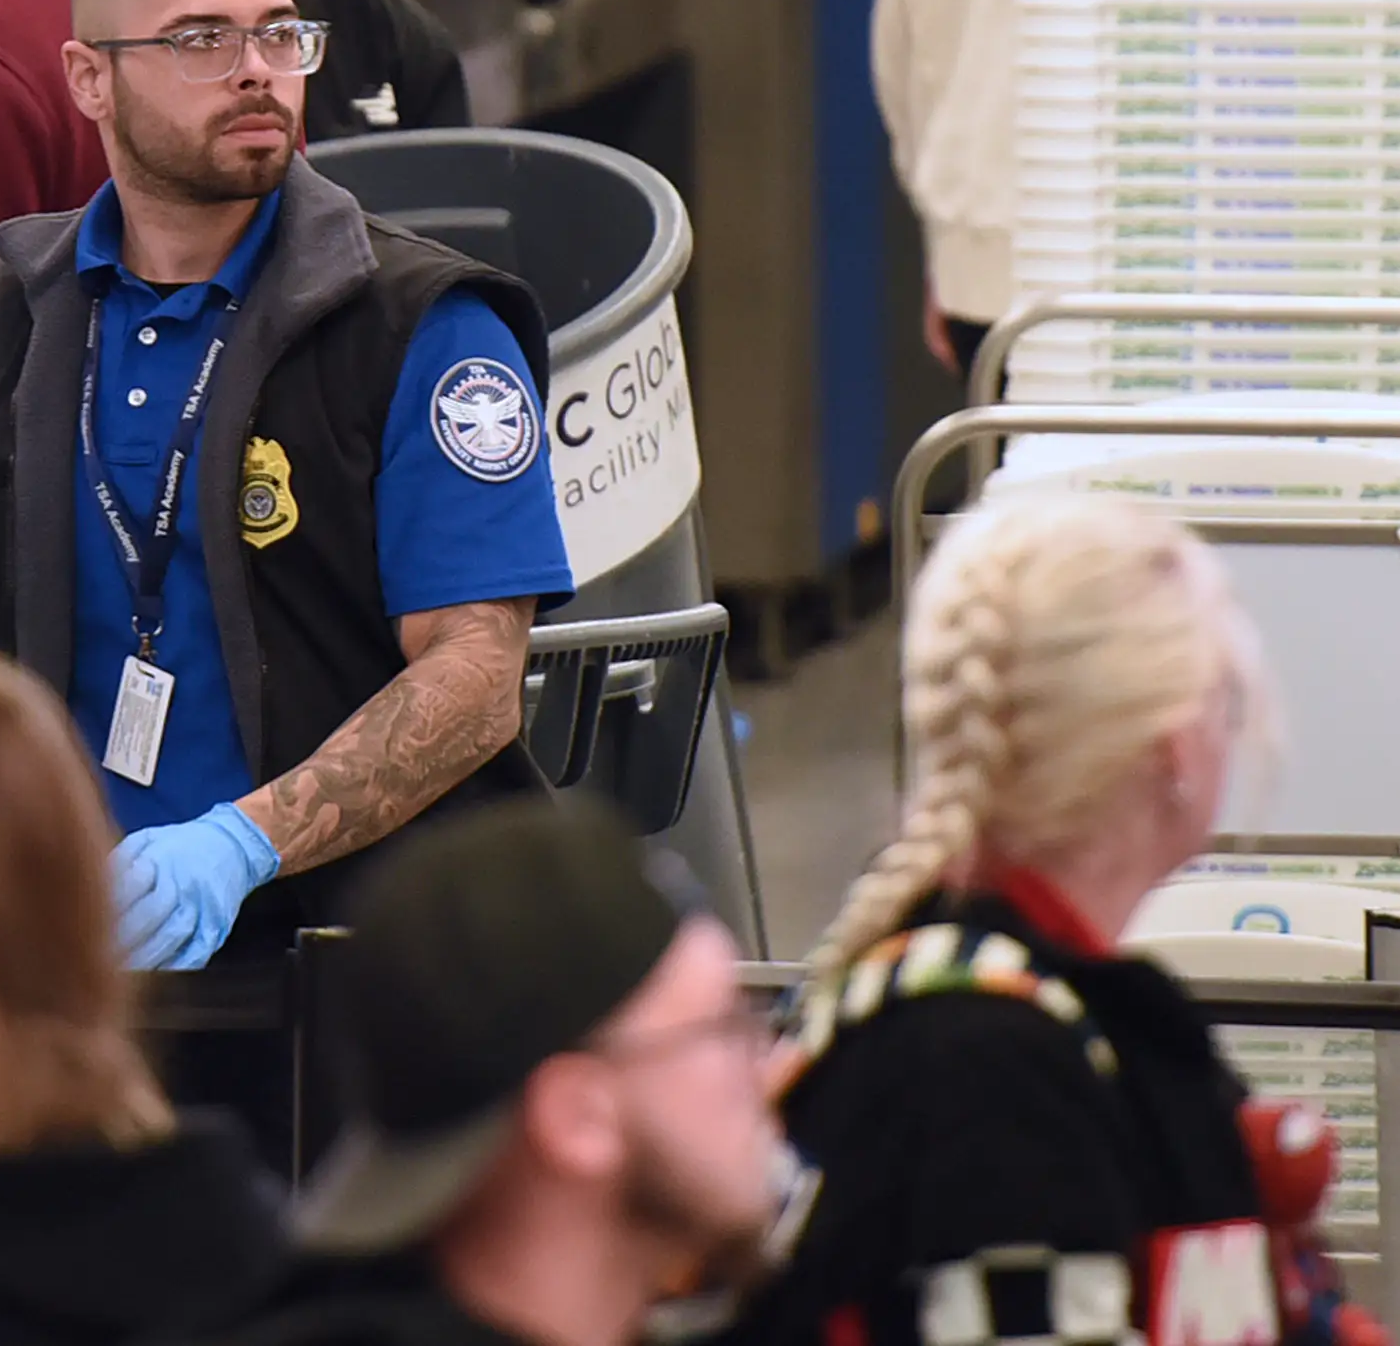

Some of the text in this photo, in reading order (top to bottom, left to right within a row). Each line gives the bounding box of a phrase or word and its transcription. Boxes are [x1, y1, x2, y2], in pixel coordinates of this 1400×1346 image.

[182, 337, 225, 420] TSA Academy
[94, 482, 141, 564] TSA Academy
[154, 449, 186, 537] TSA Academy
